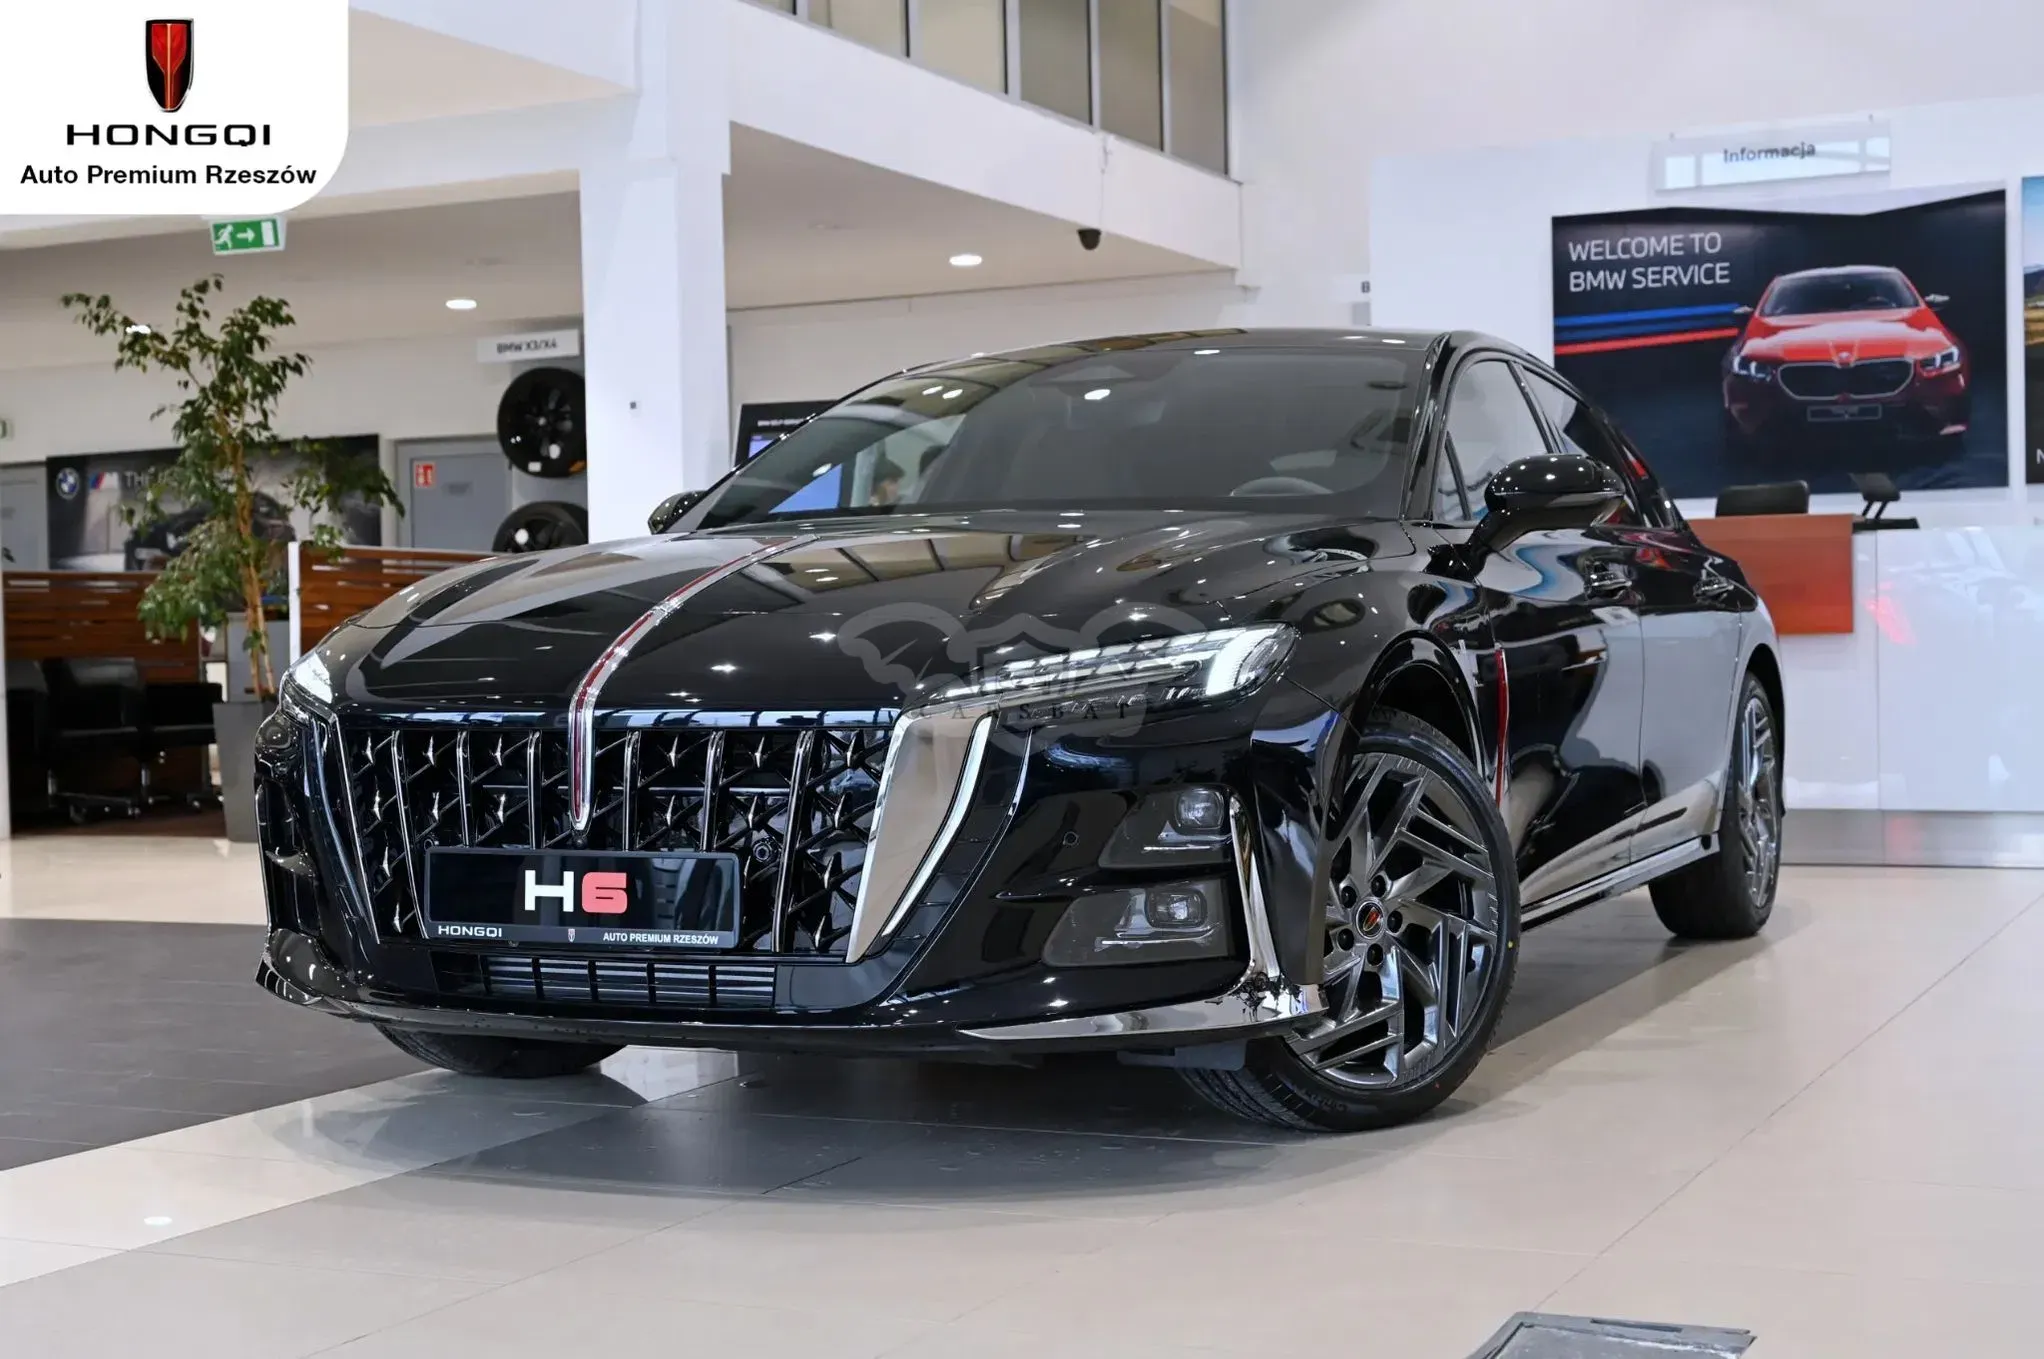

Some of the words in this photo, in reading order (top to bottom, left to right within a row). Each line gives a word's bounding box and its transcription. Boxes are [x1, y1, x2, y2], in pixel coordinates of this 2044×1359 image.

[1723, 141, 1816, 163] Informacja
[1568, 234, 1685, 262] WELCOME
[1690, 232, 1722, 254] TO
[1569, 269, 1627, 292] BMW
[1631, 262, 1731, 289] SERVICE
[524, 869, 628, 914] H6
[438, 925, 502, 938] HONGQI
[603, 932, 628, 942] AUTO
[629, 933, 672, 944] PREMIUM
[673, 934, 719, 945] RZESZÓW
